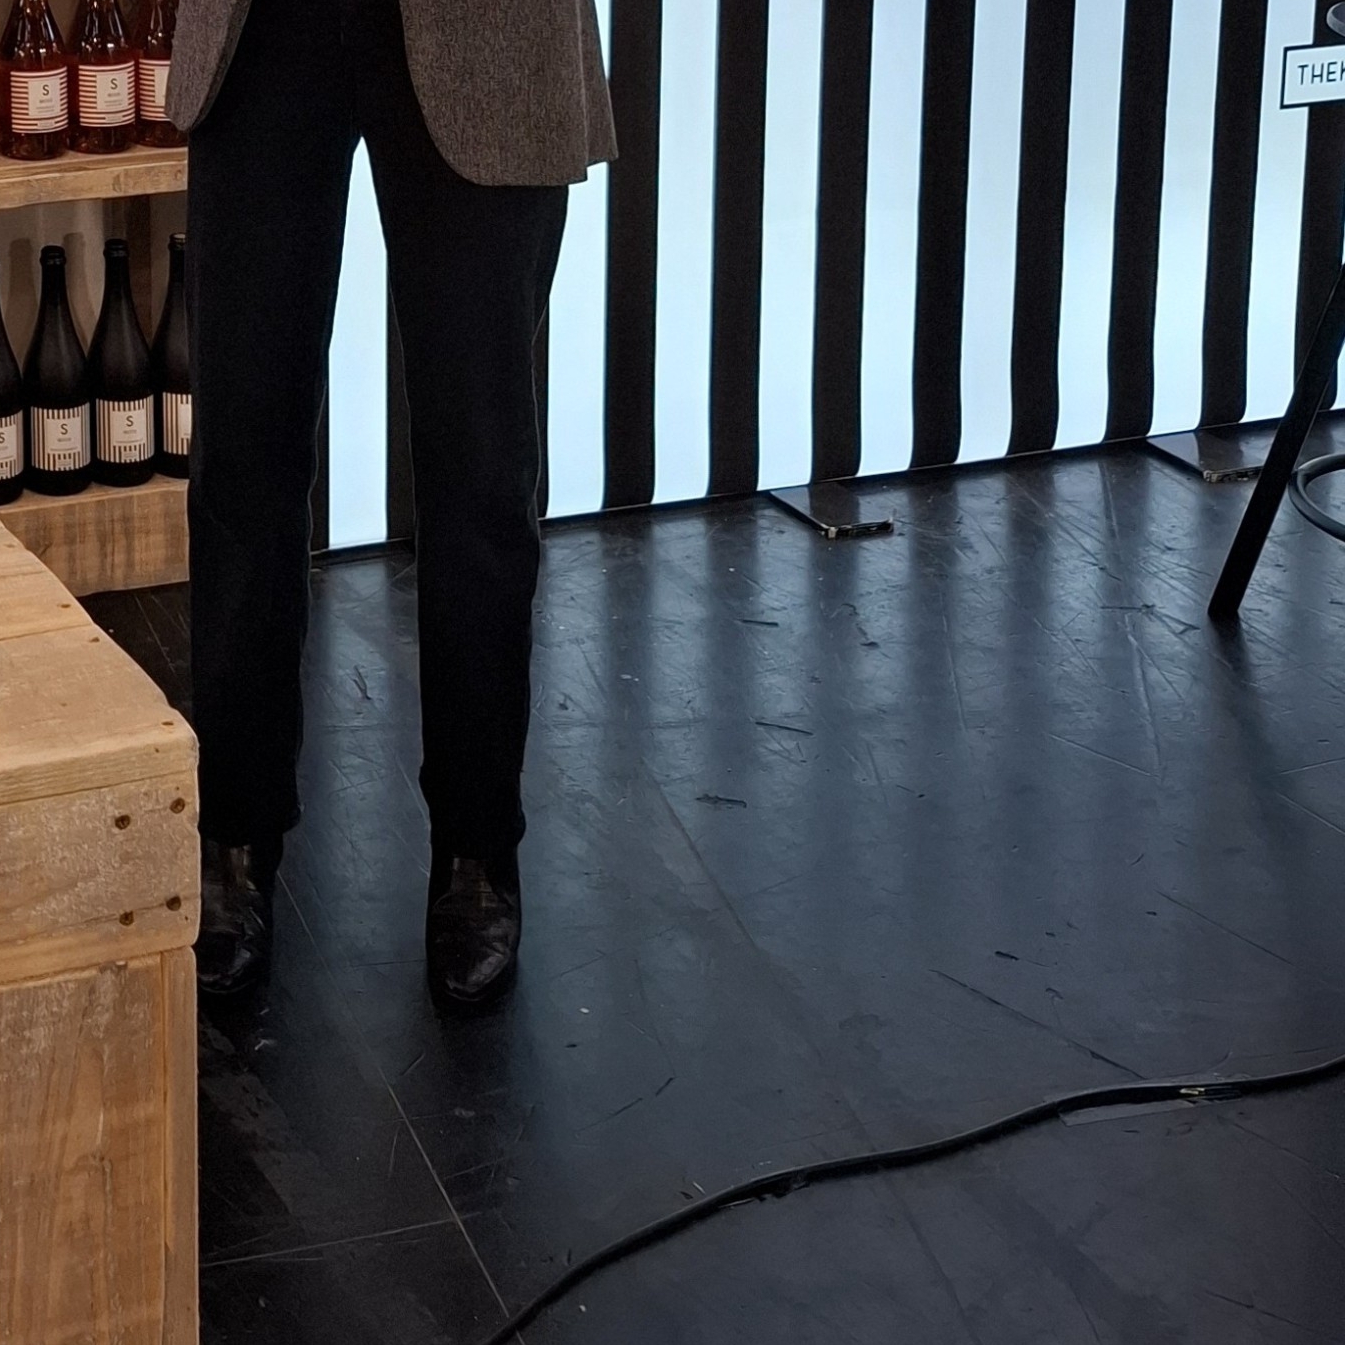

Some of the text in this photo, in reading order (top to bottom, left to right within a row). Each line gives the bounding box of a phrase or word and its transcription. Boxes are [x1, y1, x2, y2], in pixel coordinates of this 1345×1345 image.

[110, 78, 118, 89] S
[42, 85, 50, 96] S
[126, 415, 133, 427] S
[61, 423, 68, 435] S
